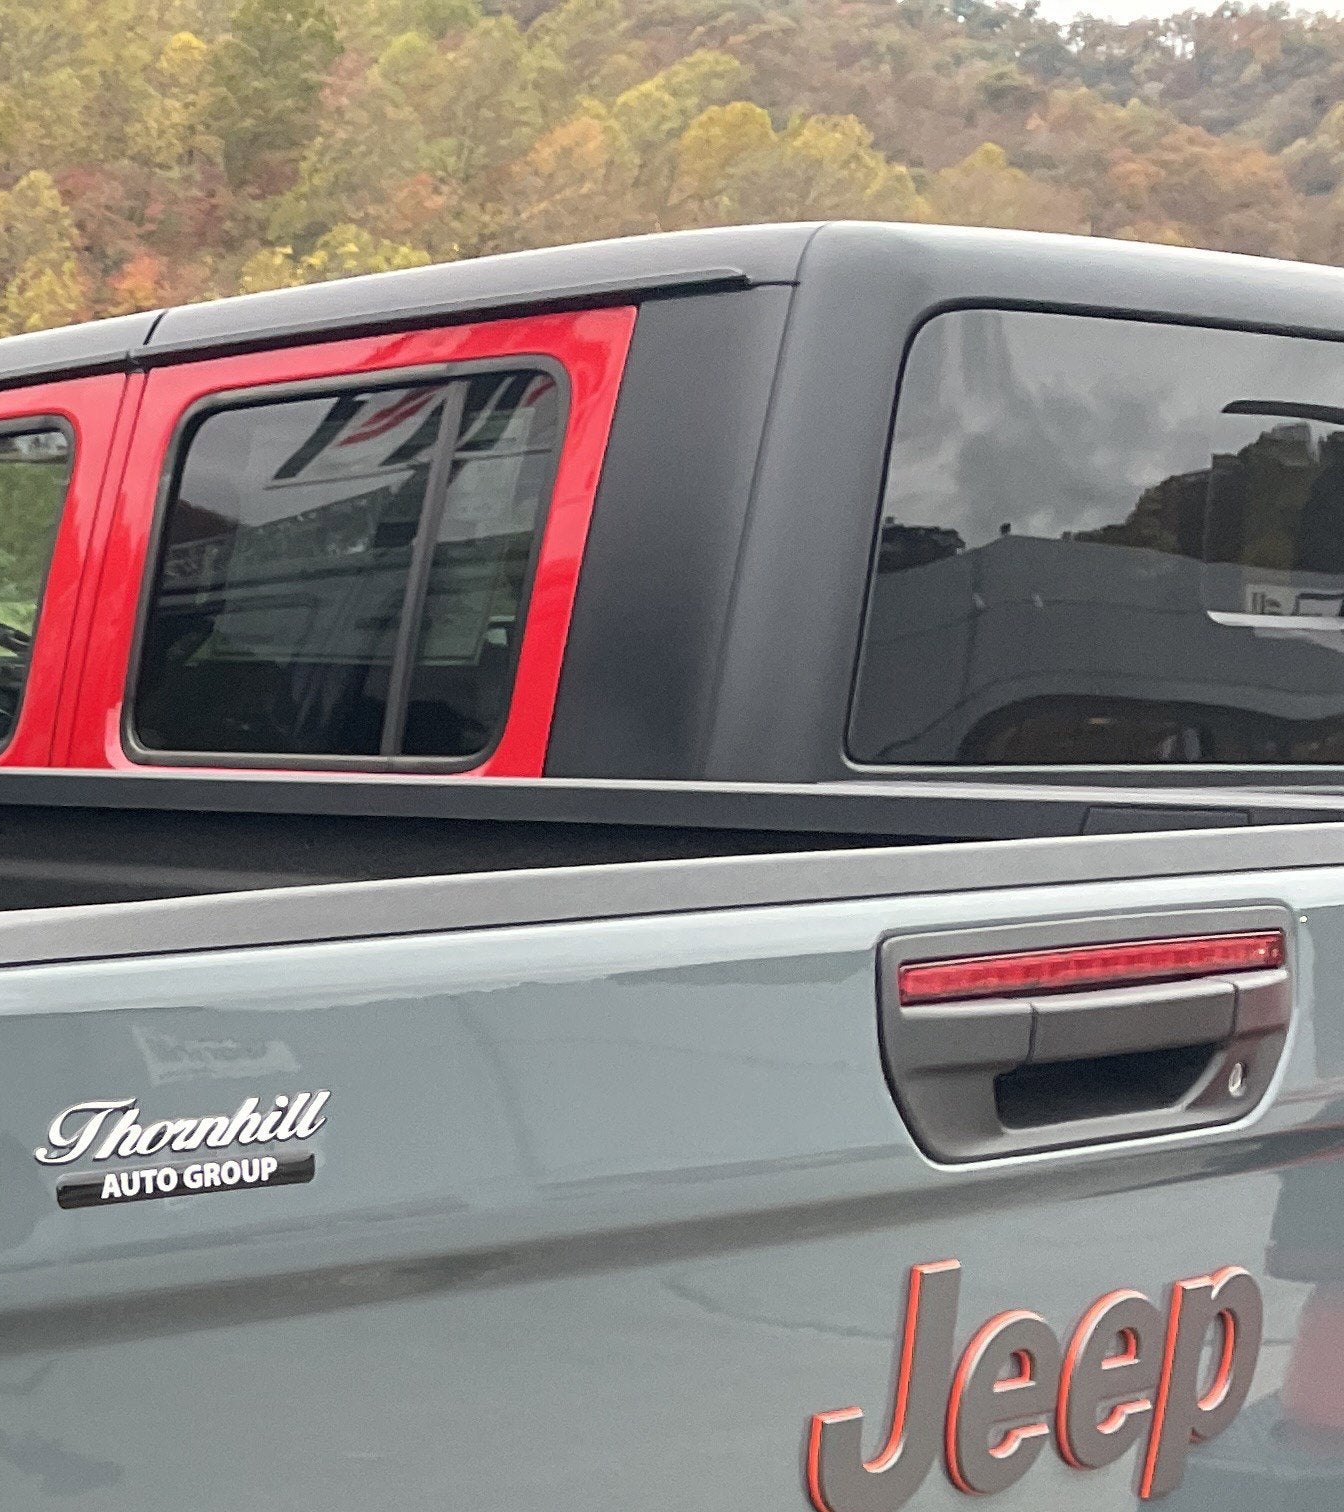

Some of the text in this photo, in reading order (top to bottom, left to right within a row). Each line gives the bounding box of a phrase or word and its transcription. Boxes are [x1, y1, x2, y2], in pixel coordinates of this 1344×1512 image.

[34, 1089, 331, 1165] Thornhill
[100, 1156, 278, 1200] AUTO GROUP
